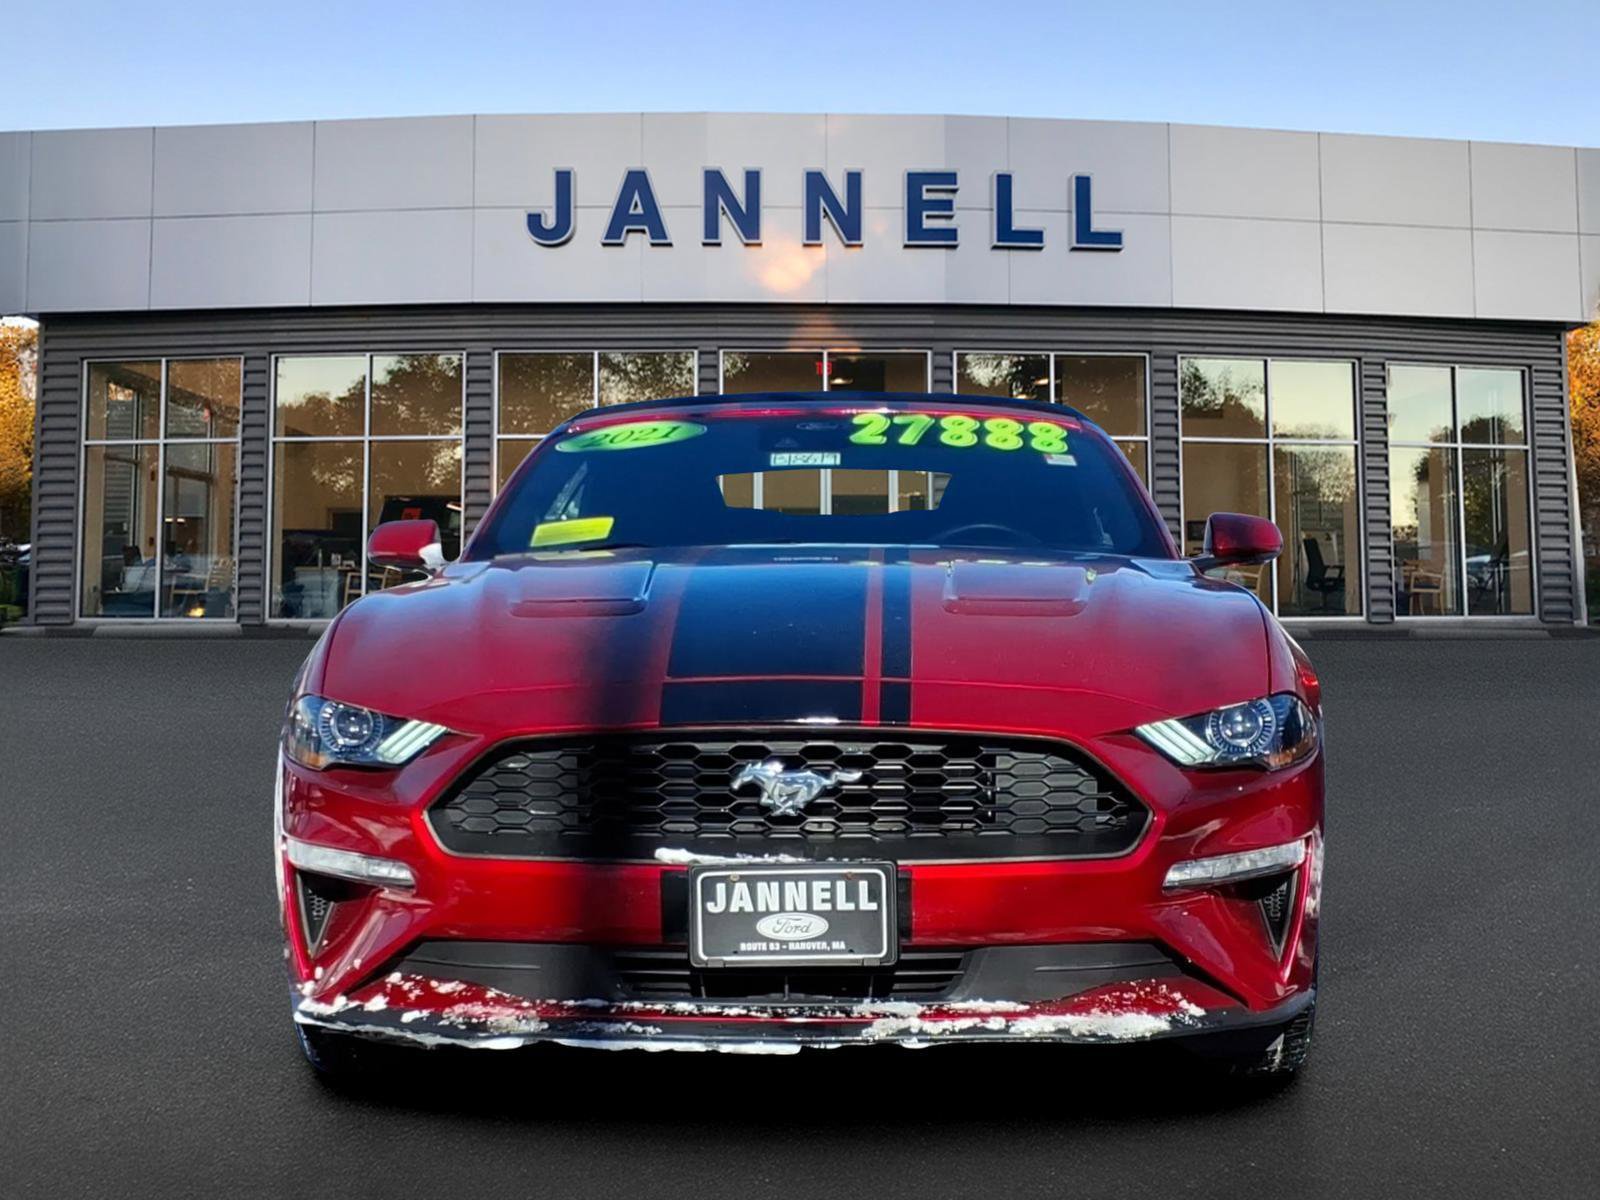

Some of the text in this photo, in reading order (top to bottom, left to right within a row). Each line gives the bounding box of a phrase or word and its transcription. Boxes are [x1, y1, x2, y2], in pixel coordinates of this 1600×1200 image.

[527, 167, 1123, 249] JANNELL
[580, 424, 682, 448] 2021
[849, 413, 1069, 454] 27888
[706, 880, 878, 913] JANNELL
[772, 917, 812, 934] Ford
[740, 942, 767, 951] ROUTE
[788, 941, 831, 951] HANOVER,
[831, 940, 846, 950] MA
